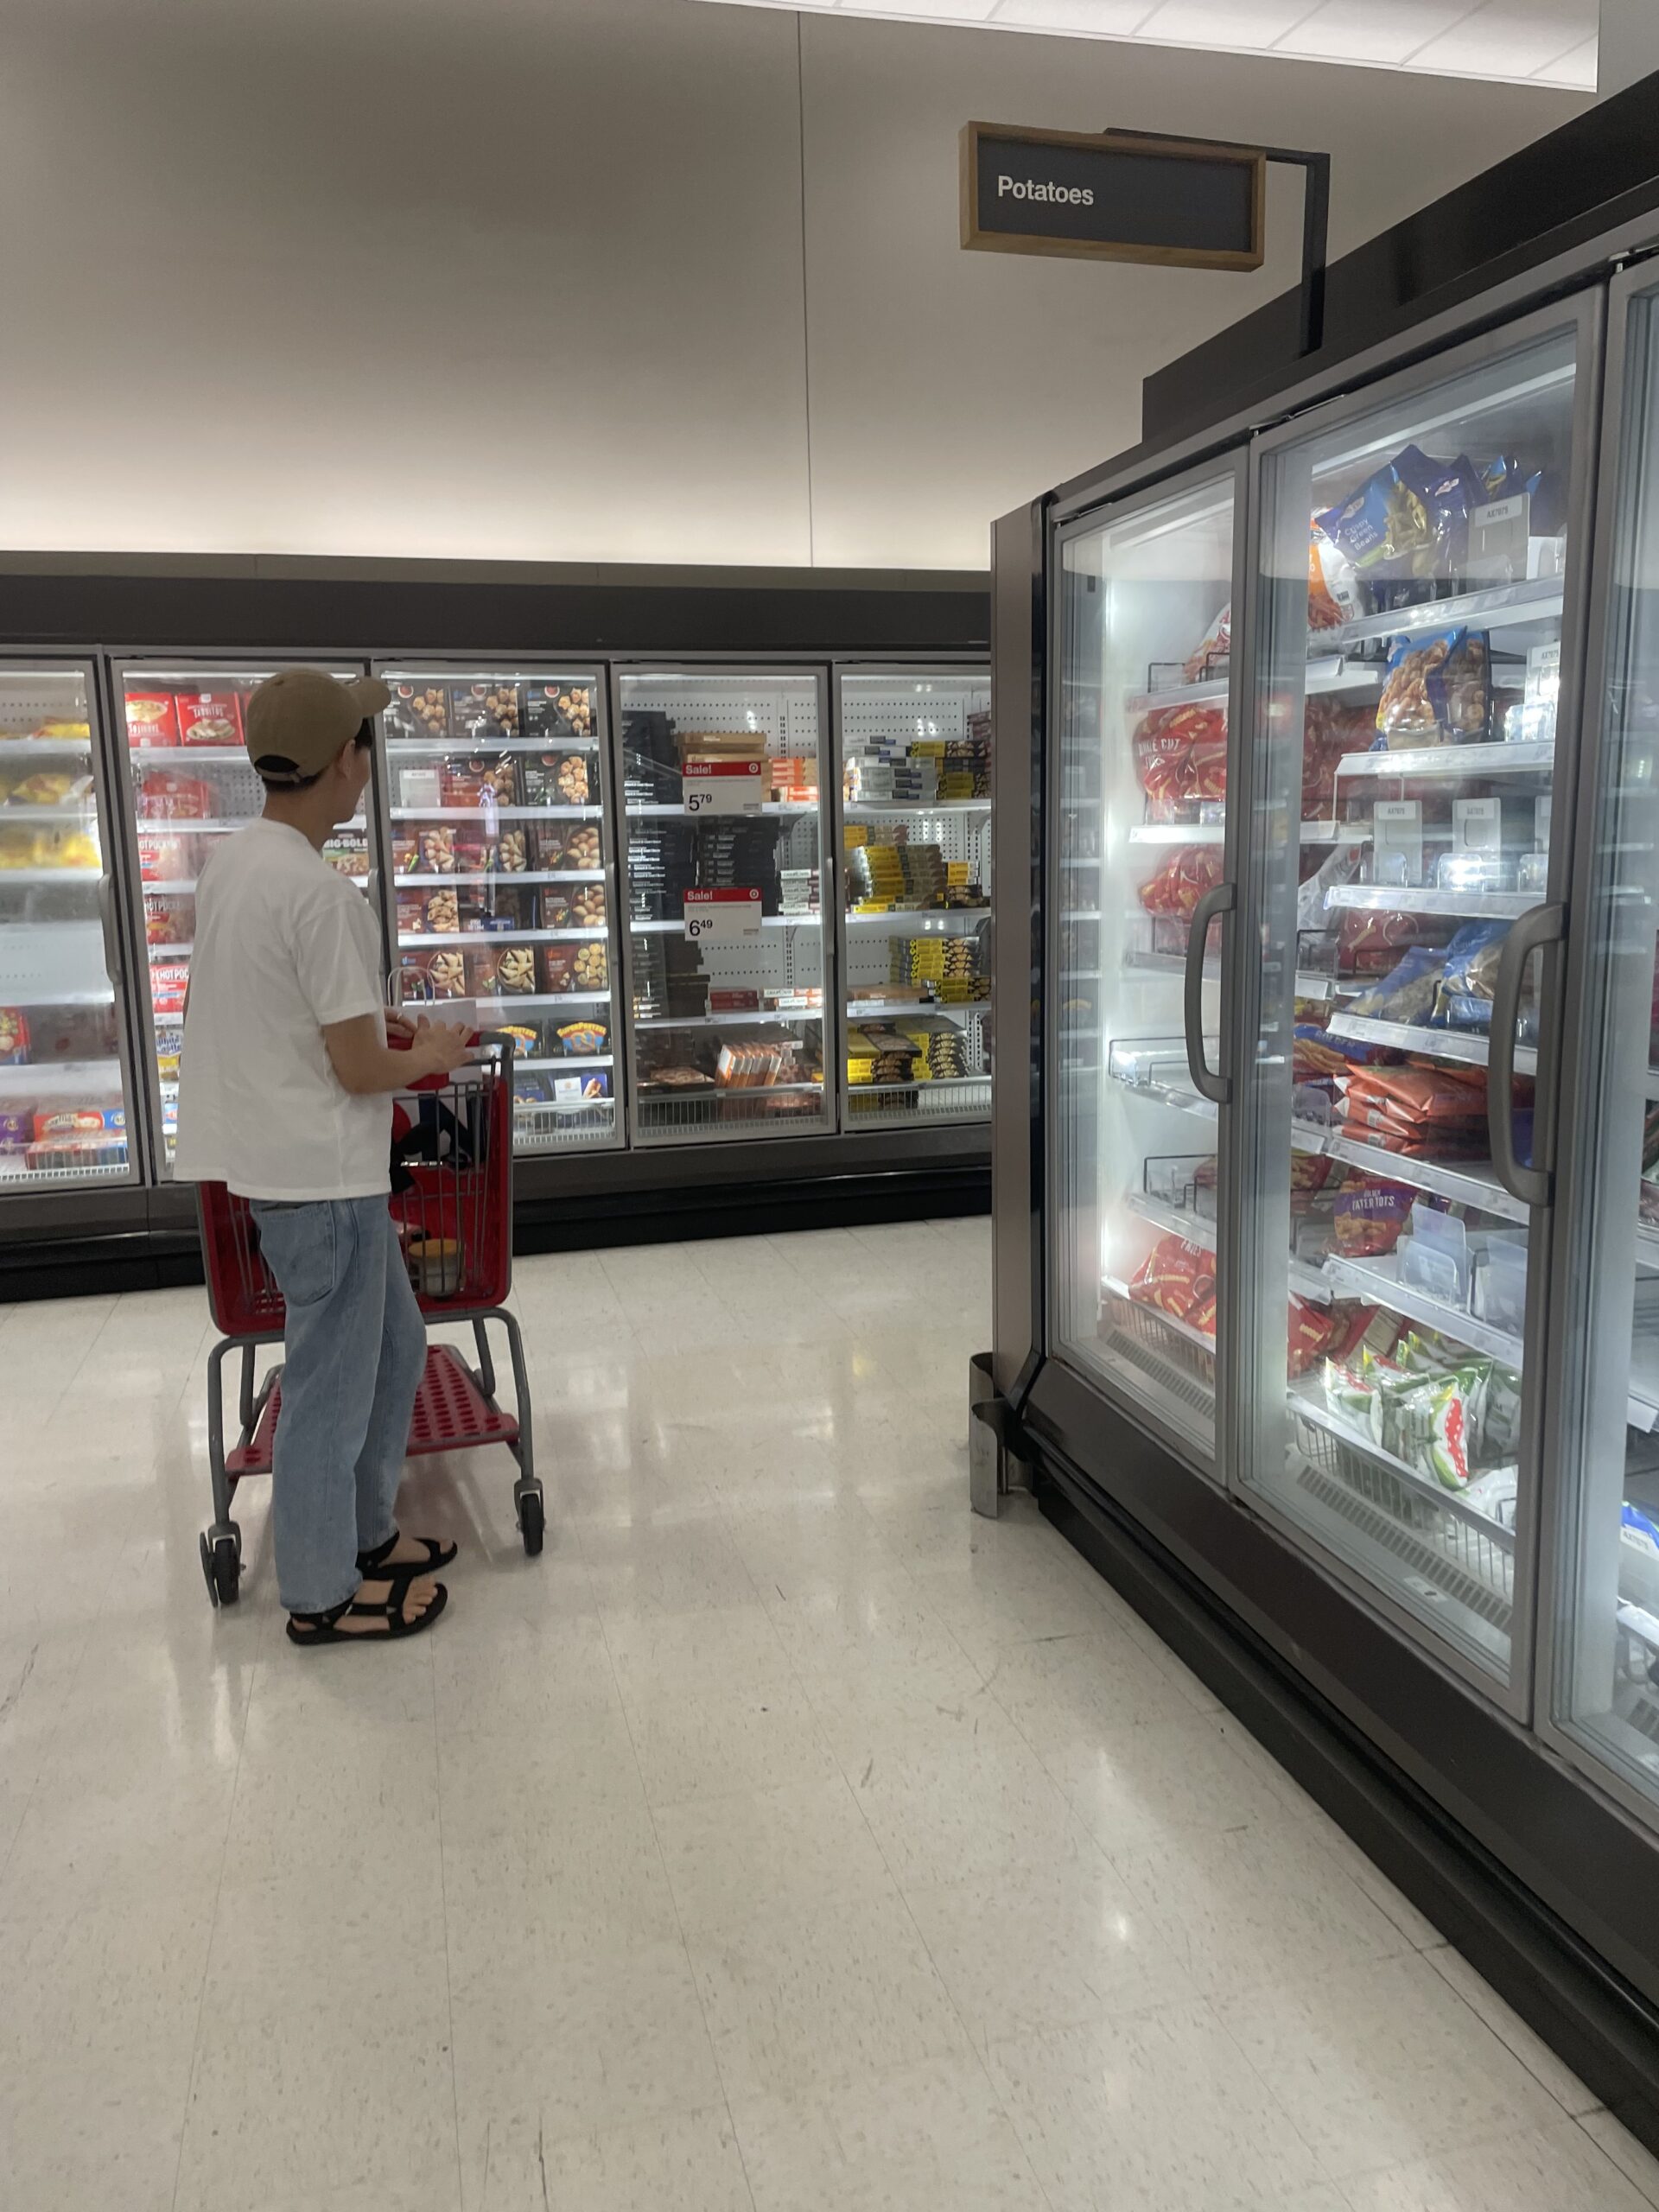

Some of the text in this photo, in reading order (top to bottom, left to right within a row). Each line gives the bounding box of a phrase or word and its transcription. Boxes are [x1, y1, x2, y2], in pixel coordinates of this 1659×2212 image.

[998, 175, 1094, 206] Potatoes
[1349, 524, 1373, 543] Green
[1354, 531, 1378, 550] Beans
[685, 763, 712, 775] Sale!
[687, 889, 714, 901] Sale!
[160, 968, 174, 981] HOT
